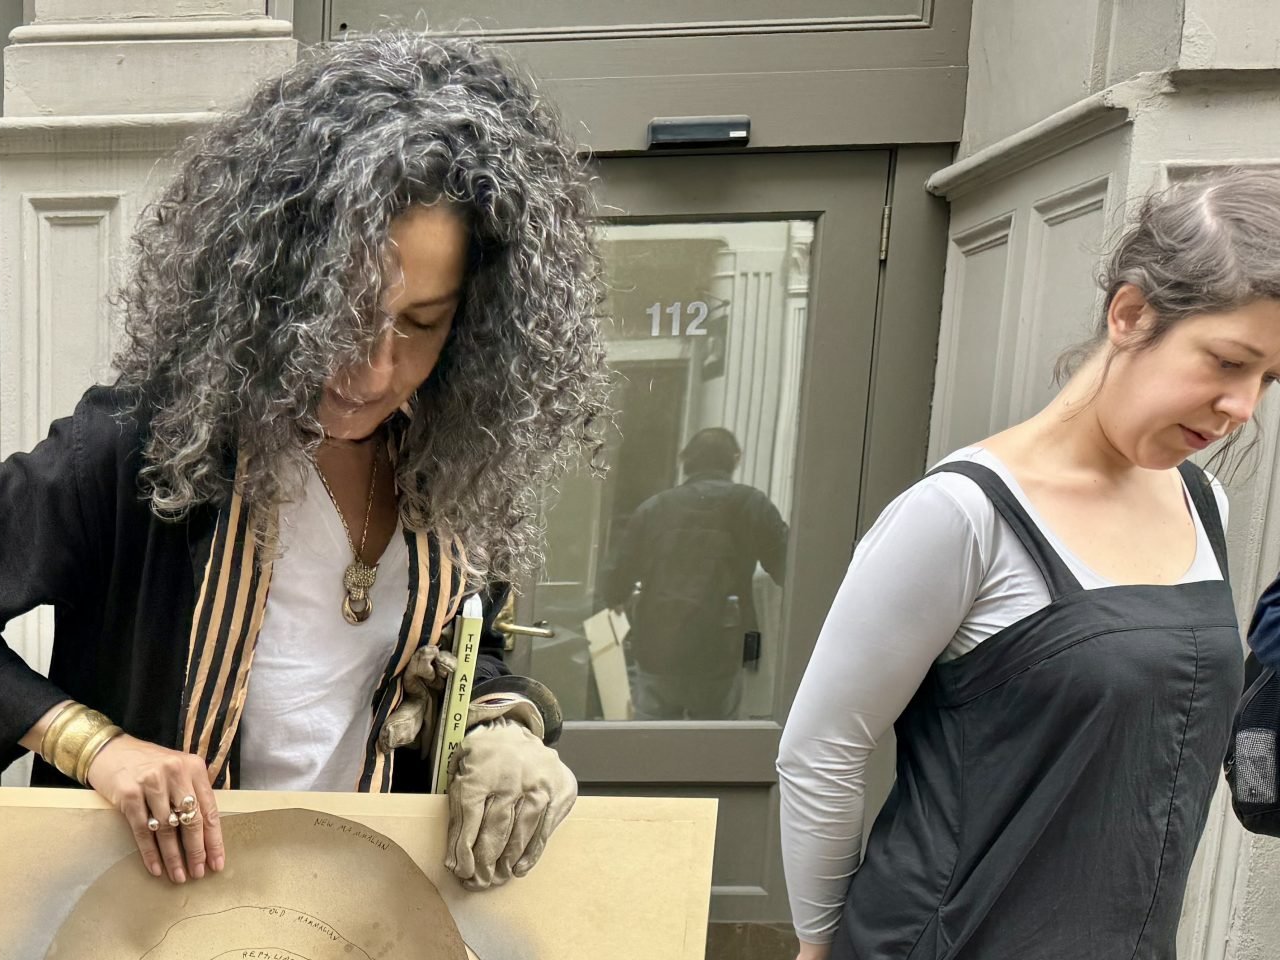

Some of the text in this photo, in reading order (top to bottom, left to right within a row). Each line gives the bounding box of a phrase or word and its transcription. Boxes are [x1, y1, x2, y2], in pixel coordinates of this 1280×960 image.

[645, 301, 708, 337] 112
[464, 633, 475, 663] THE
[458, 673, 468, 703] ART
[453, 713, 462, 731] OF
